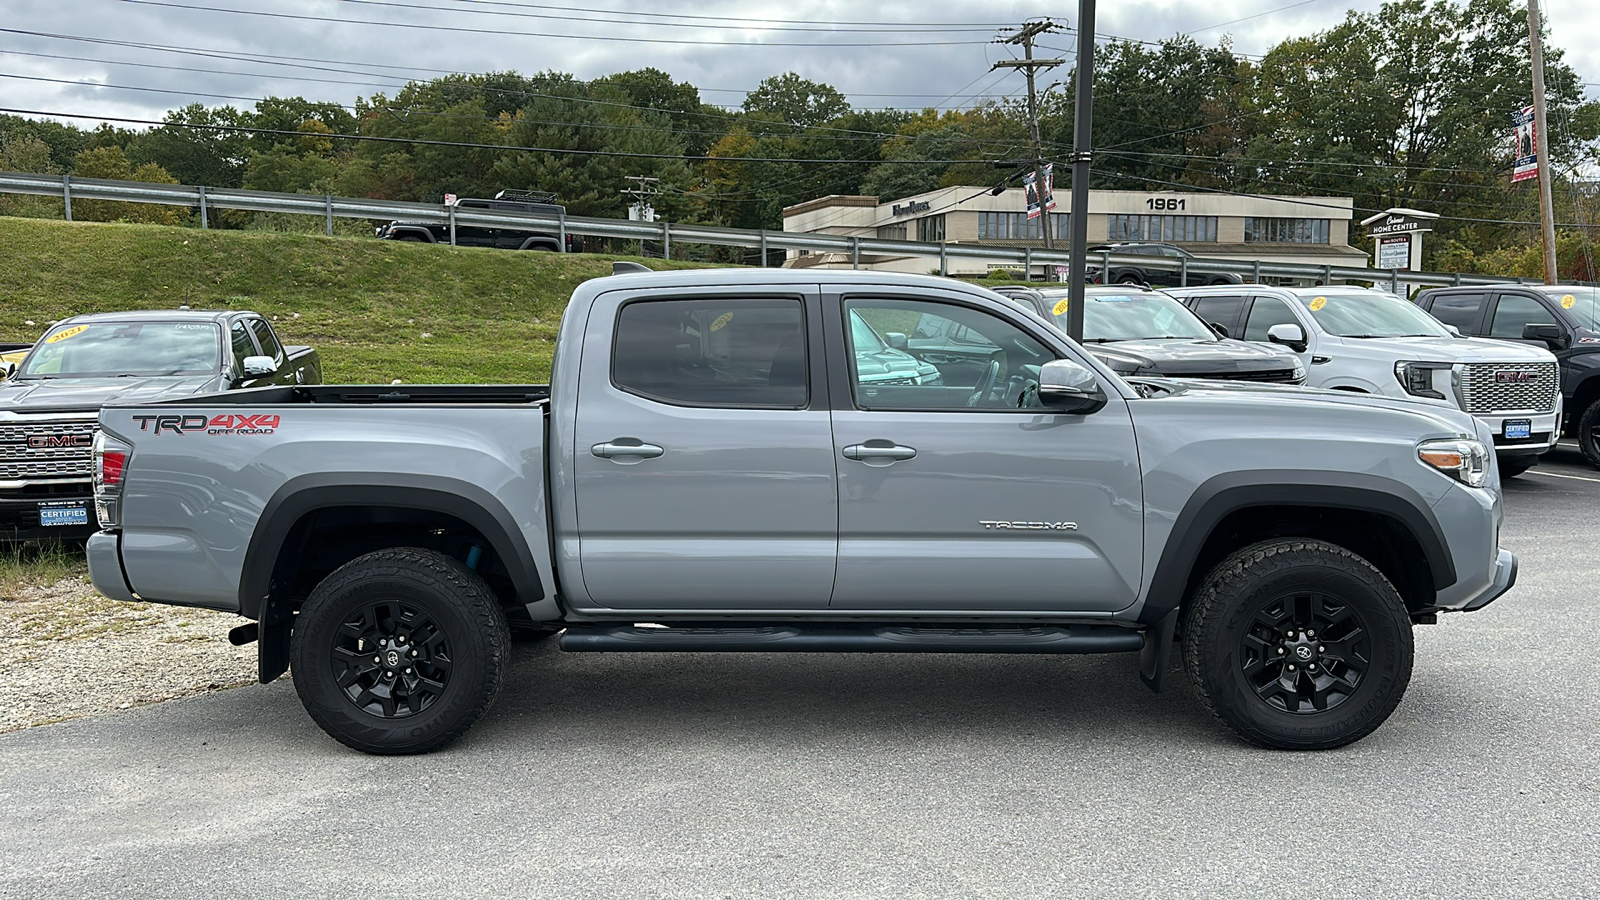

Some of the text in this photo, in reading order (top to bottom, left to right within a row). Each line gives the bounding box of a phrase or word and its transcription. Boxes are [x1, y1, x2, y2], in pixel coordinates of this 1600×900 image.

[1146, 198, 1186, 211] 1961
[1392, 222, 1418, 231] CENTER
[53, 326, 82, 342] 2021
[1497, 371, 1538, 383] GMC
[132, 414, 209, 436] TRD
[207, 428, 275, 436] OFF ROAD
[28, 434, 91, 448] GMC
[41, 510, 86, 518] CERTIFIED
[979, 520, 1078, 530] TACOMA
